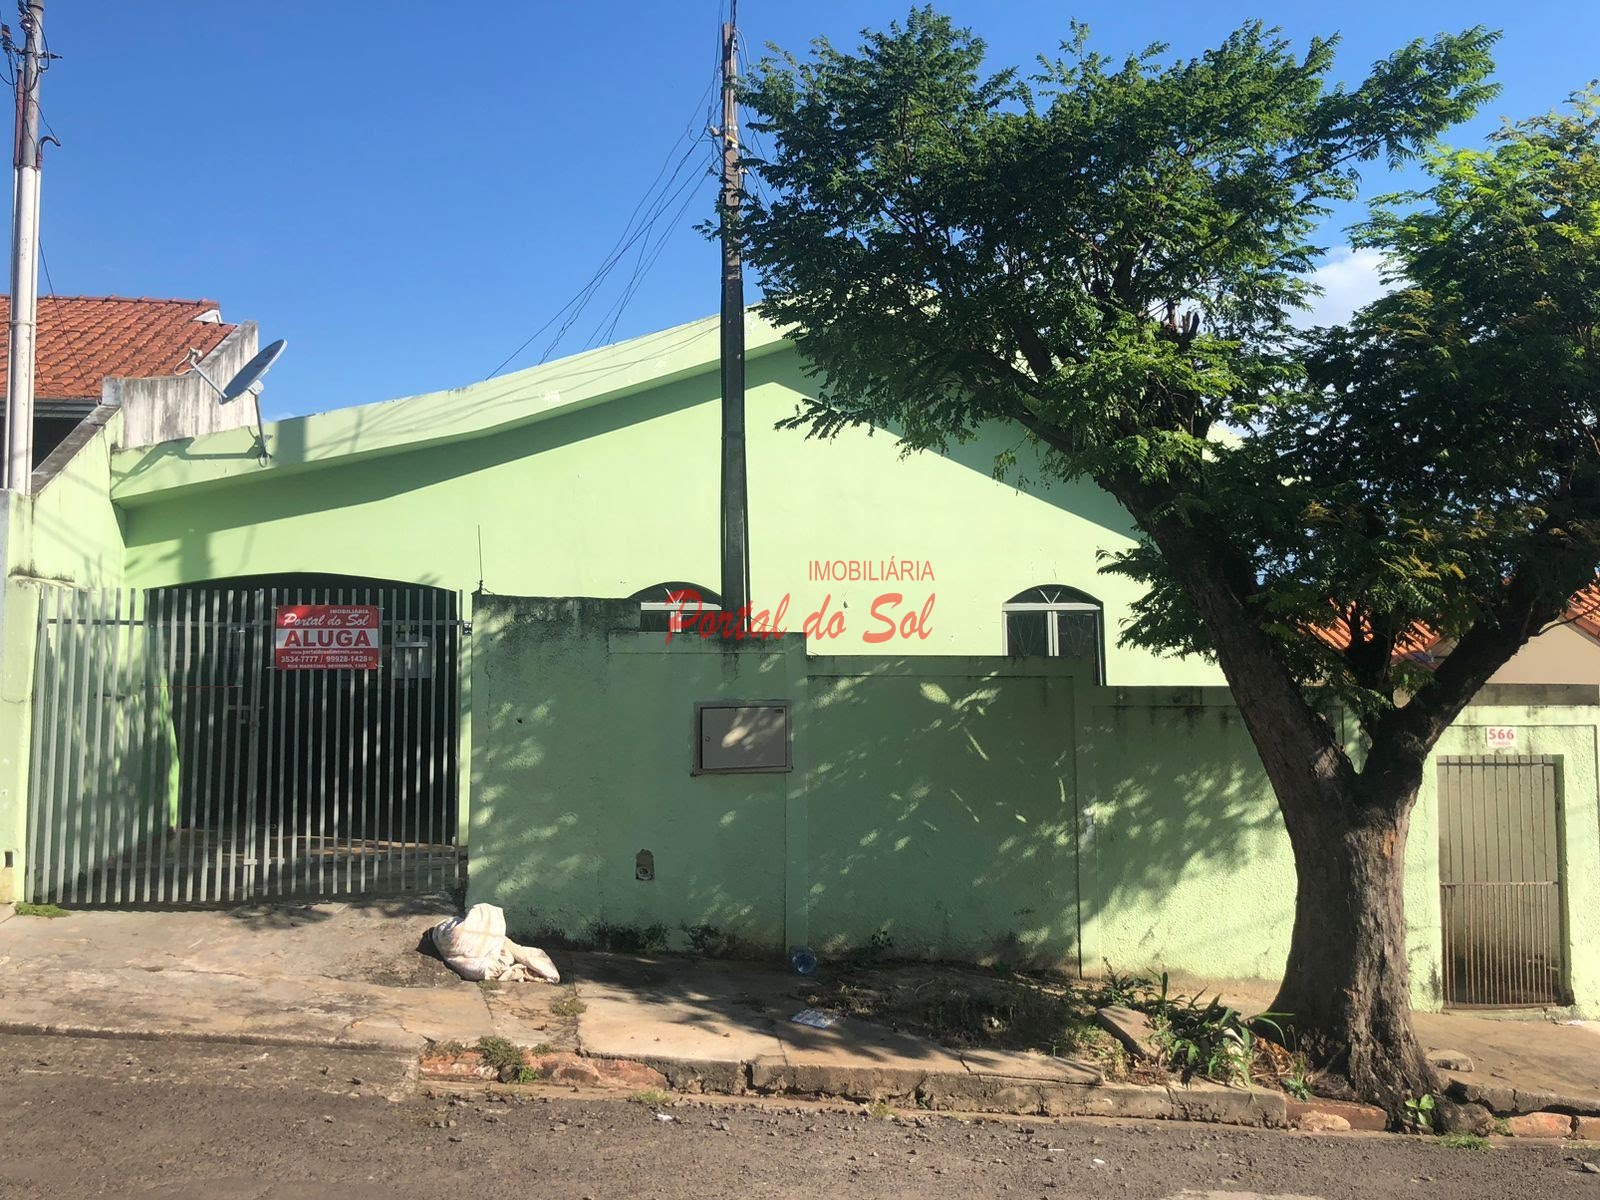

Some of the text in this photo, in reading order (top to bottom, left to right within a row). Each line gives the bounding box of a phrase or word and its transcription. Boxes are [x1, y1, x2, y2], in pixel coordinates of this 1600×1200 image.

[283, 612, 370, 626] Portal do Sol
[284, 630, 371, 647] ALUGA
[1489, 728, 1514, 740] 566
